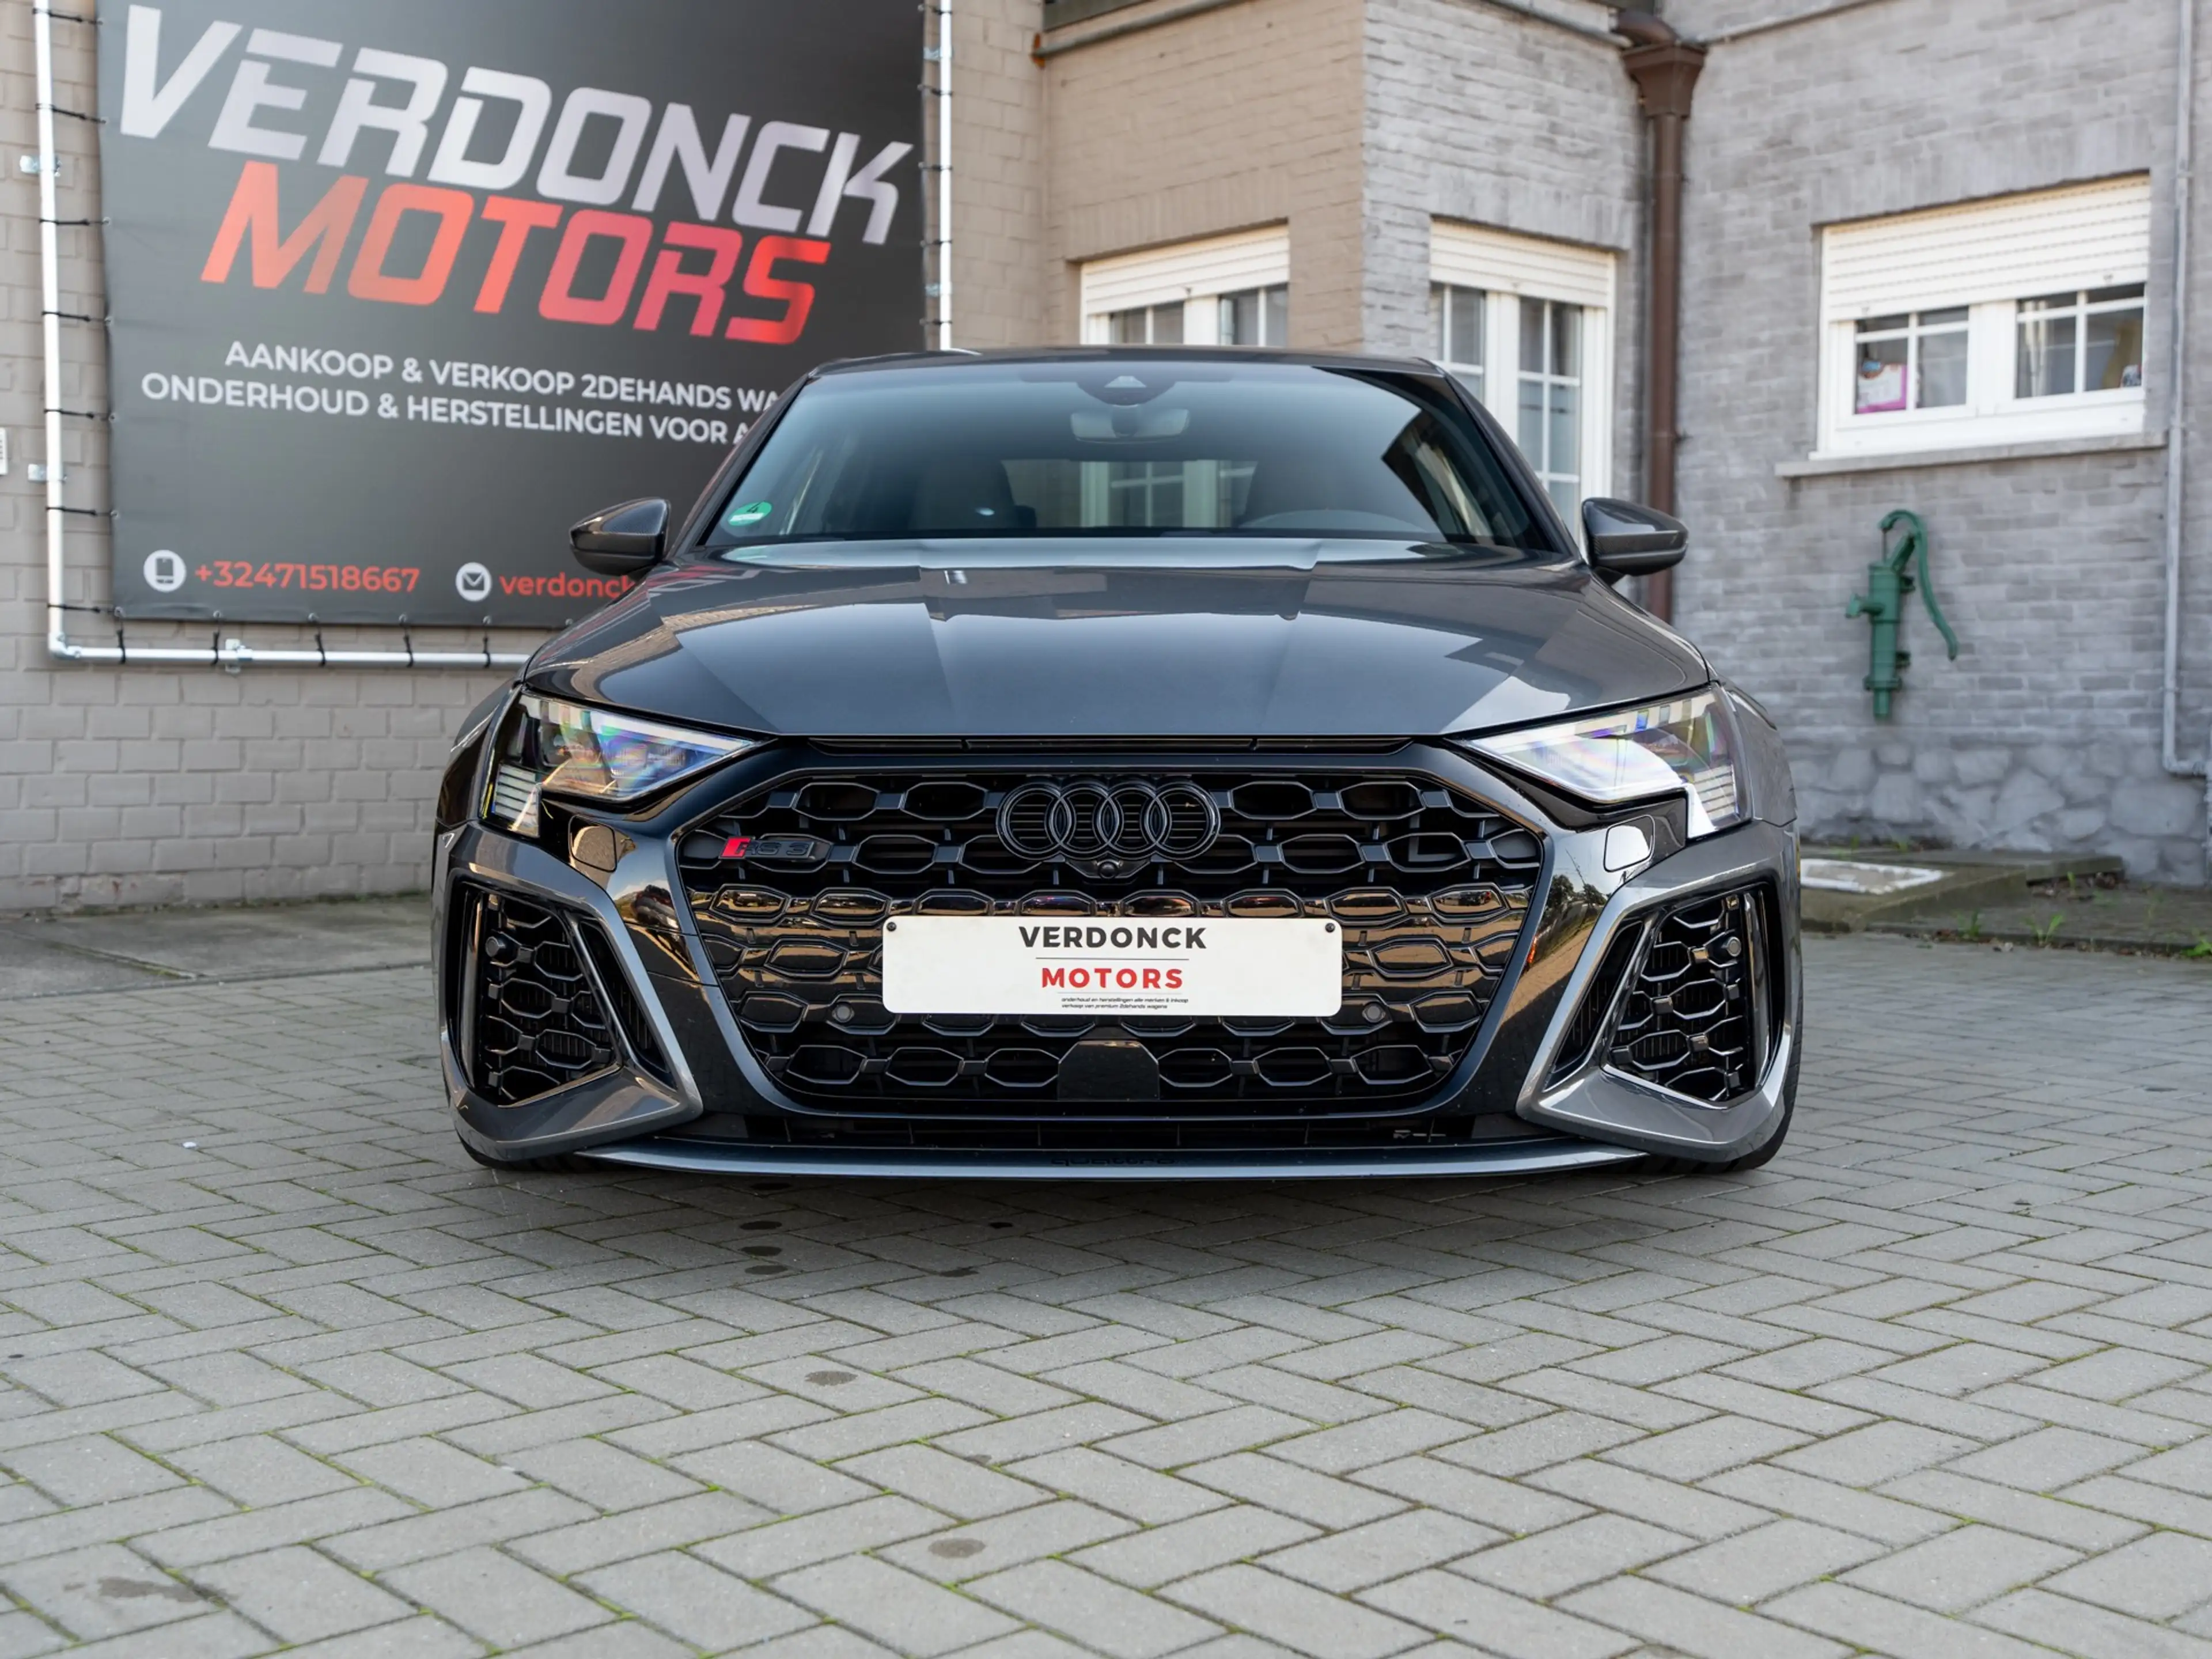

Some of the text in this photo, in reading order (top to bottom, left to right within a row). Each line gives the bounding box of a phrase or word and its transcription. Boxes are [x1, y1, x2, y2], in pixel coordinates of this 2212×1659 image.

[119, 5, 913, 246] VERDONCK
[200, 160, 831, 345] MOTORS
[225, 341, 393, 380] AANKOOP
[401, 357, 423, 384] &
[429, 360, 574, 396] VERKOOP
[581, 371, 732, 410] 2DEHANDS
[141, 372, 369, 416] ONDERHOUD
[377, 395, 399, 419] &
[406, 397, 642, 438] HERSTELLINGEN
[649, 415, 728, 445] VOOR
[195, 561, 420, 593] +32471518667
[735, 842, 808, 855] RS 3
[1018, 926, 1207, 949] VERDONCK
[1042, 968, 1183, 988] MOTORS
